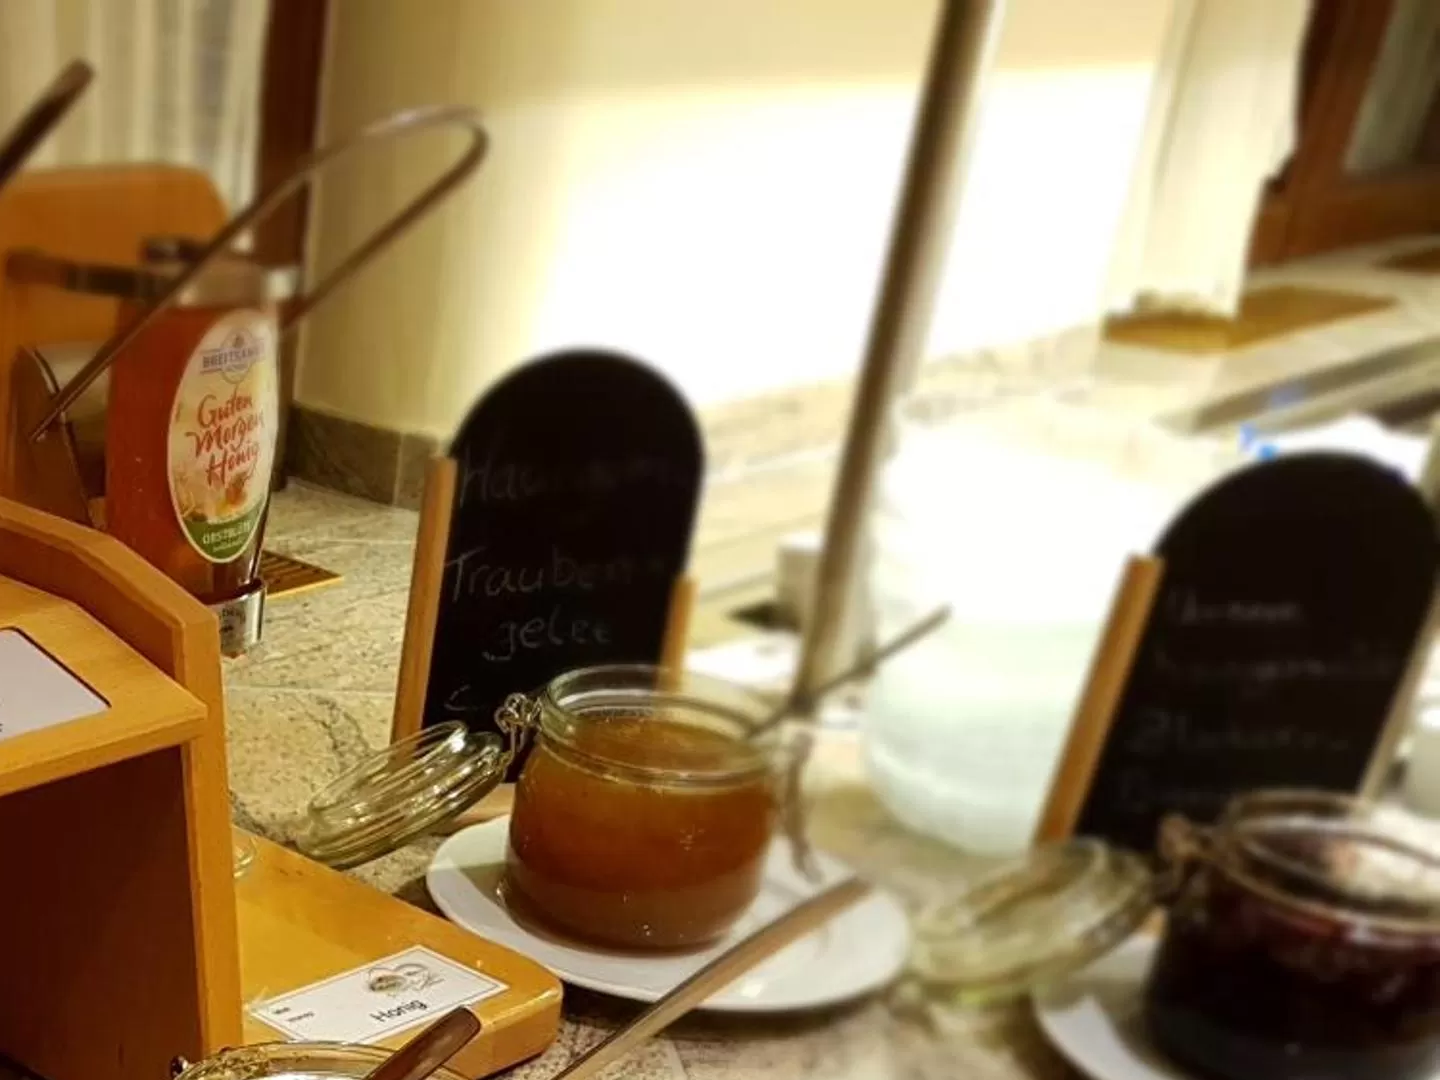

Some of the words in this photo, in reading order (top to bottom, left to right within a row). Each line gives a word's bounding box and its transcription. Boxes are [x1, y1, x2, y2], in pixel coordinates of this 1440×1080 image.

[197, 389, 253, 428] Guten
[185, 411, 265, 457] Morgen
[205, 442, 262, 486] Honig
[369, 998, 429, 1023] Honig
